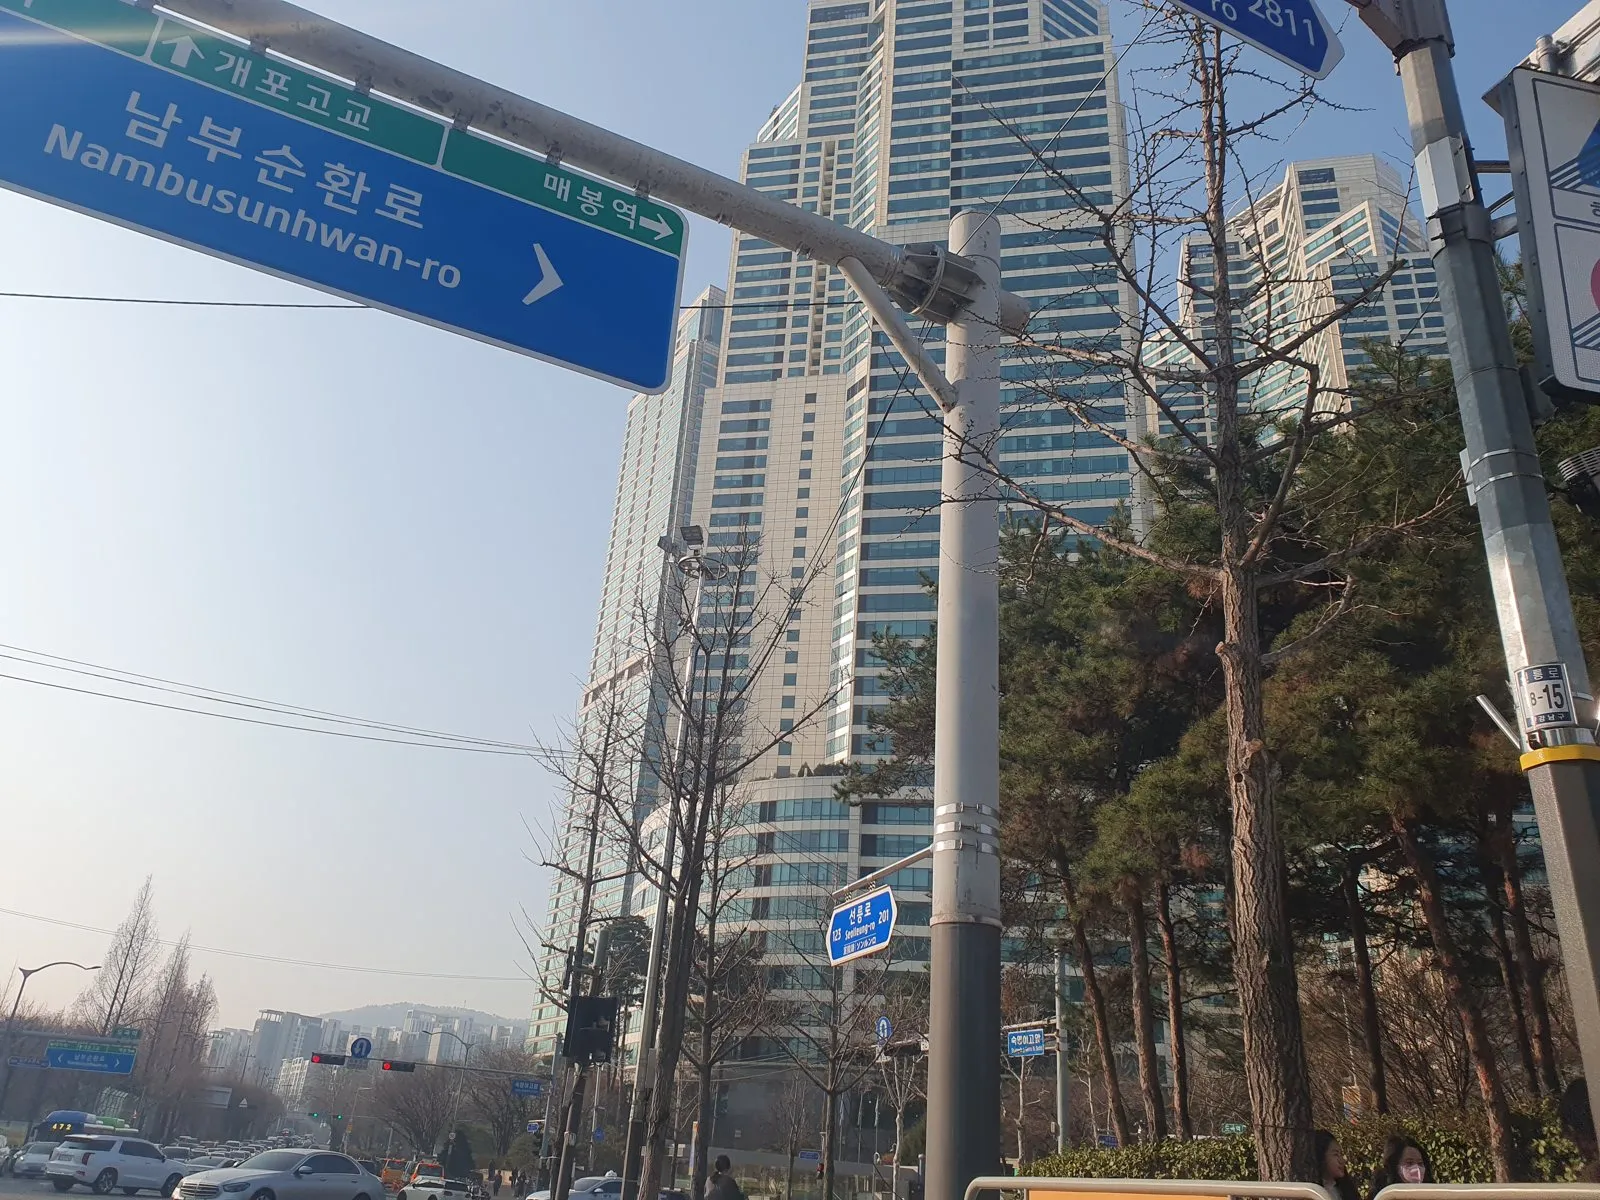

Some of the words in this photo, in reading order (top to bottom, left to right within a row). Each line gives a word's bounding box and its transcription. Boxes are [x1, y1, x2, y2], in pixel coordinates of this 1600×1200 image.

[1248, 0, 1315, 46] 2811
[214, 49, 371, 131] 개포고교
[126, 91, 424, 229] 남부순환로
[43, 123, 462, 289] Nambusunhwan-ro
[543, 172, 638, 229] 매봉역
[833, 928, 841, 942] 123
[849, 902, 871, 925] 선릉로
[878, 909, 889, 924] 201
[52, 1123, 72, 1132] 472
